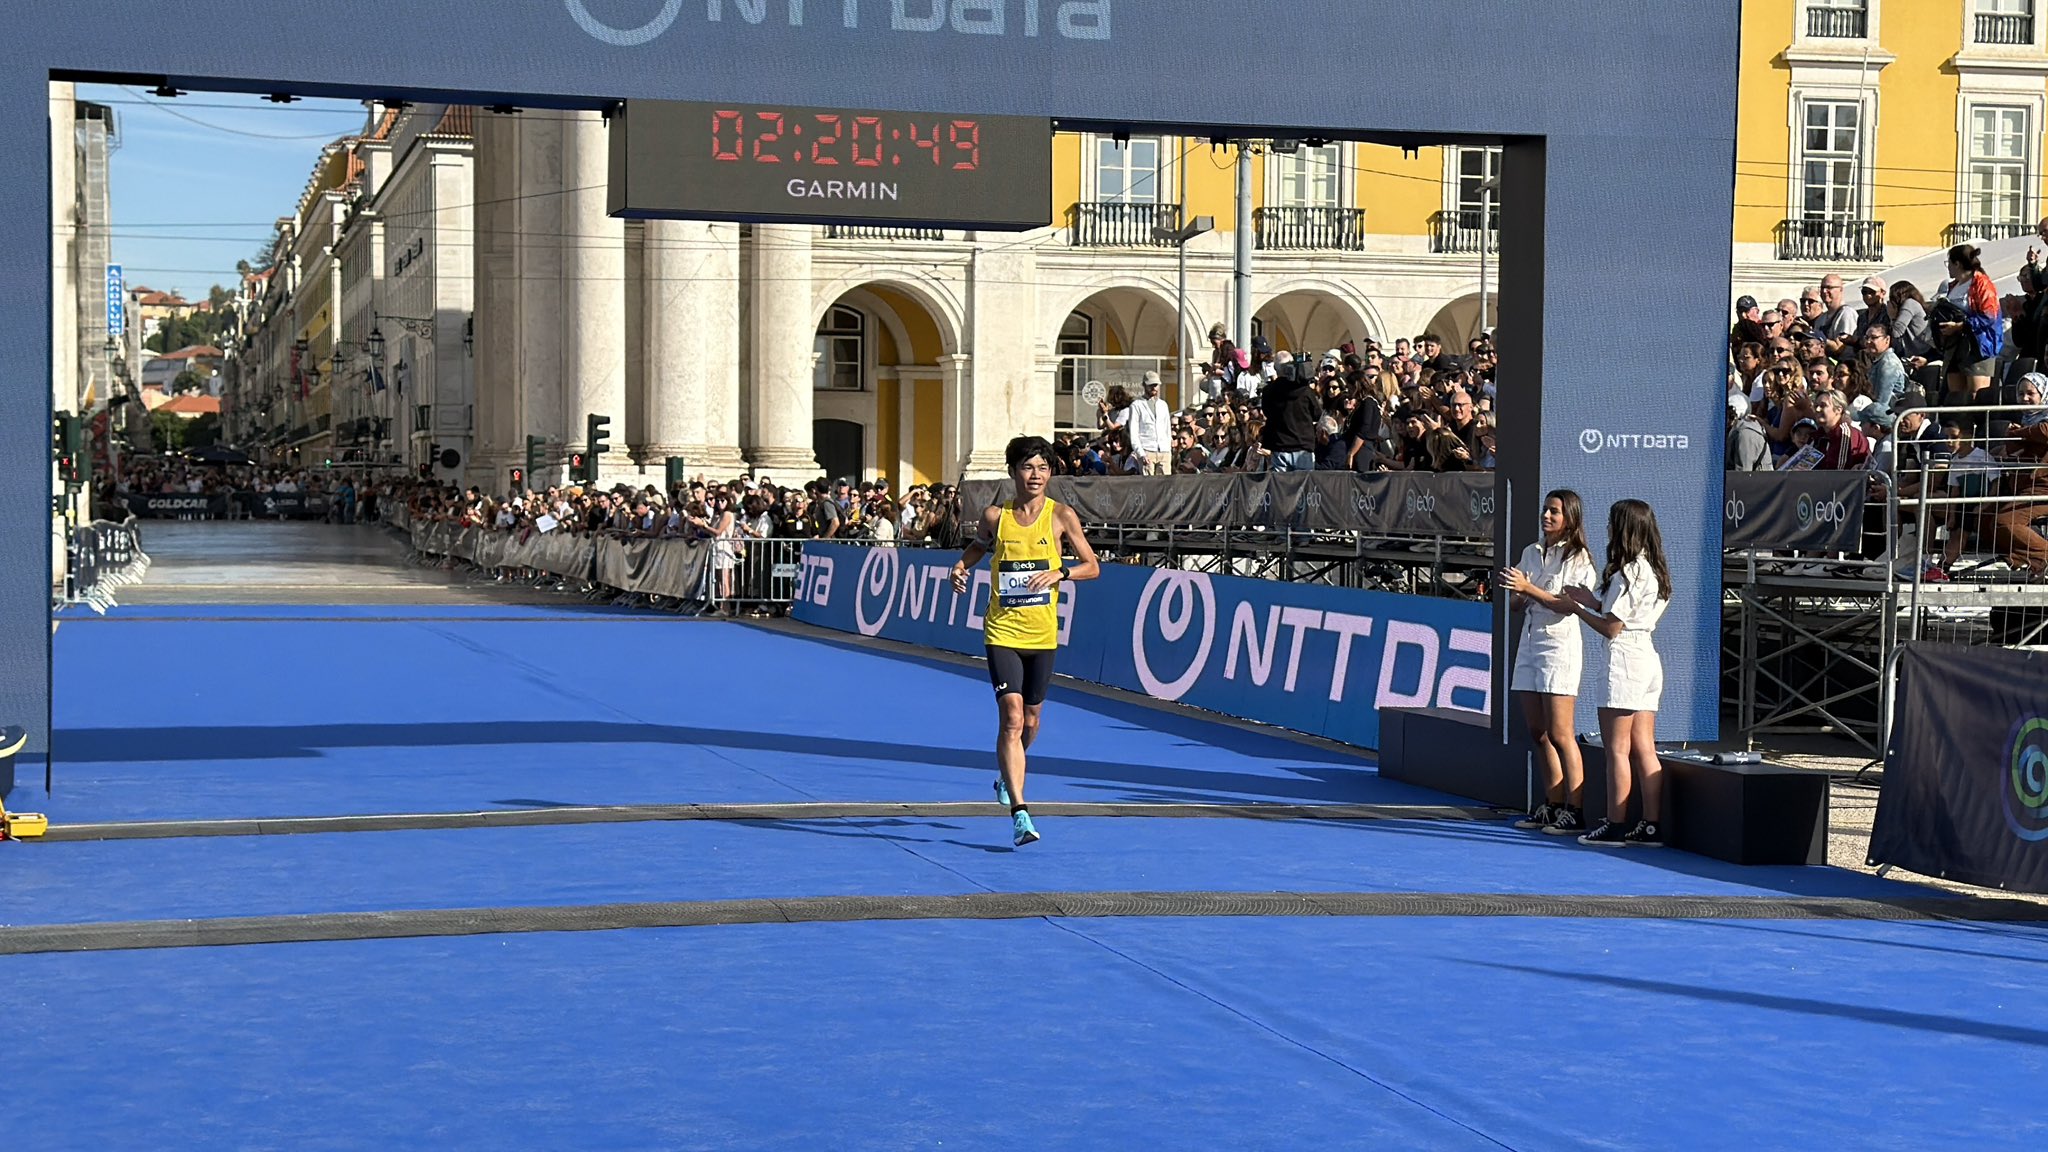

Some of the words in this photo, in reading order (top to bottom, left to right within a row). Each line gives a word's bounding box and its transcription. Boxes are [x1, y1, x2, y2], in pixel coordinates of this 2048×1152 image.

[712, 110, 979, 169] 02:20:49
[786, 178, 898, 200] GARMIN
[1606, 434, 1641, 448] NTT
[147, 498, 208, 509] GOLDCAR
[1306, 485, 1322, 513] edp
[1358, 487, 1376, 517] edp
[1416, 487, 1435, 518] edp
[1815, 491, 1845, 531] edp
[1020, 561, 1036, 571] edp
[1224, 600, 1373, 702] NTT
